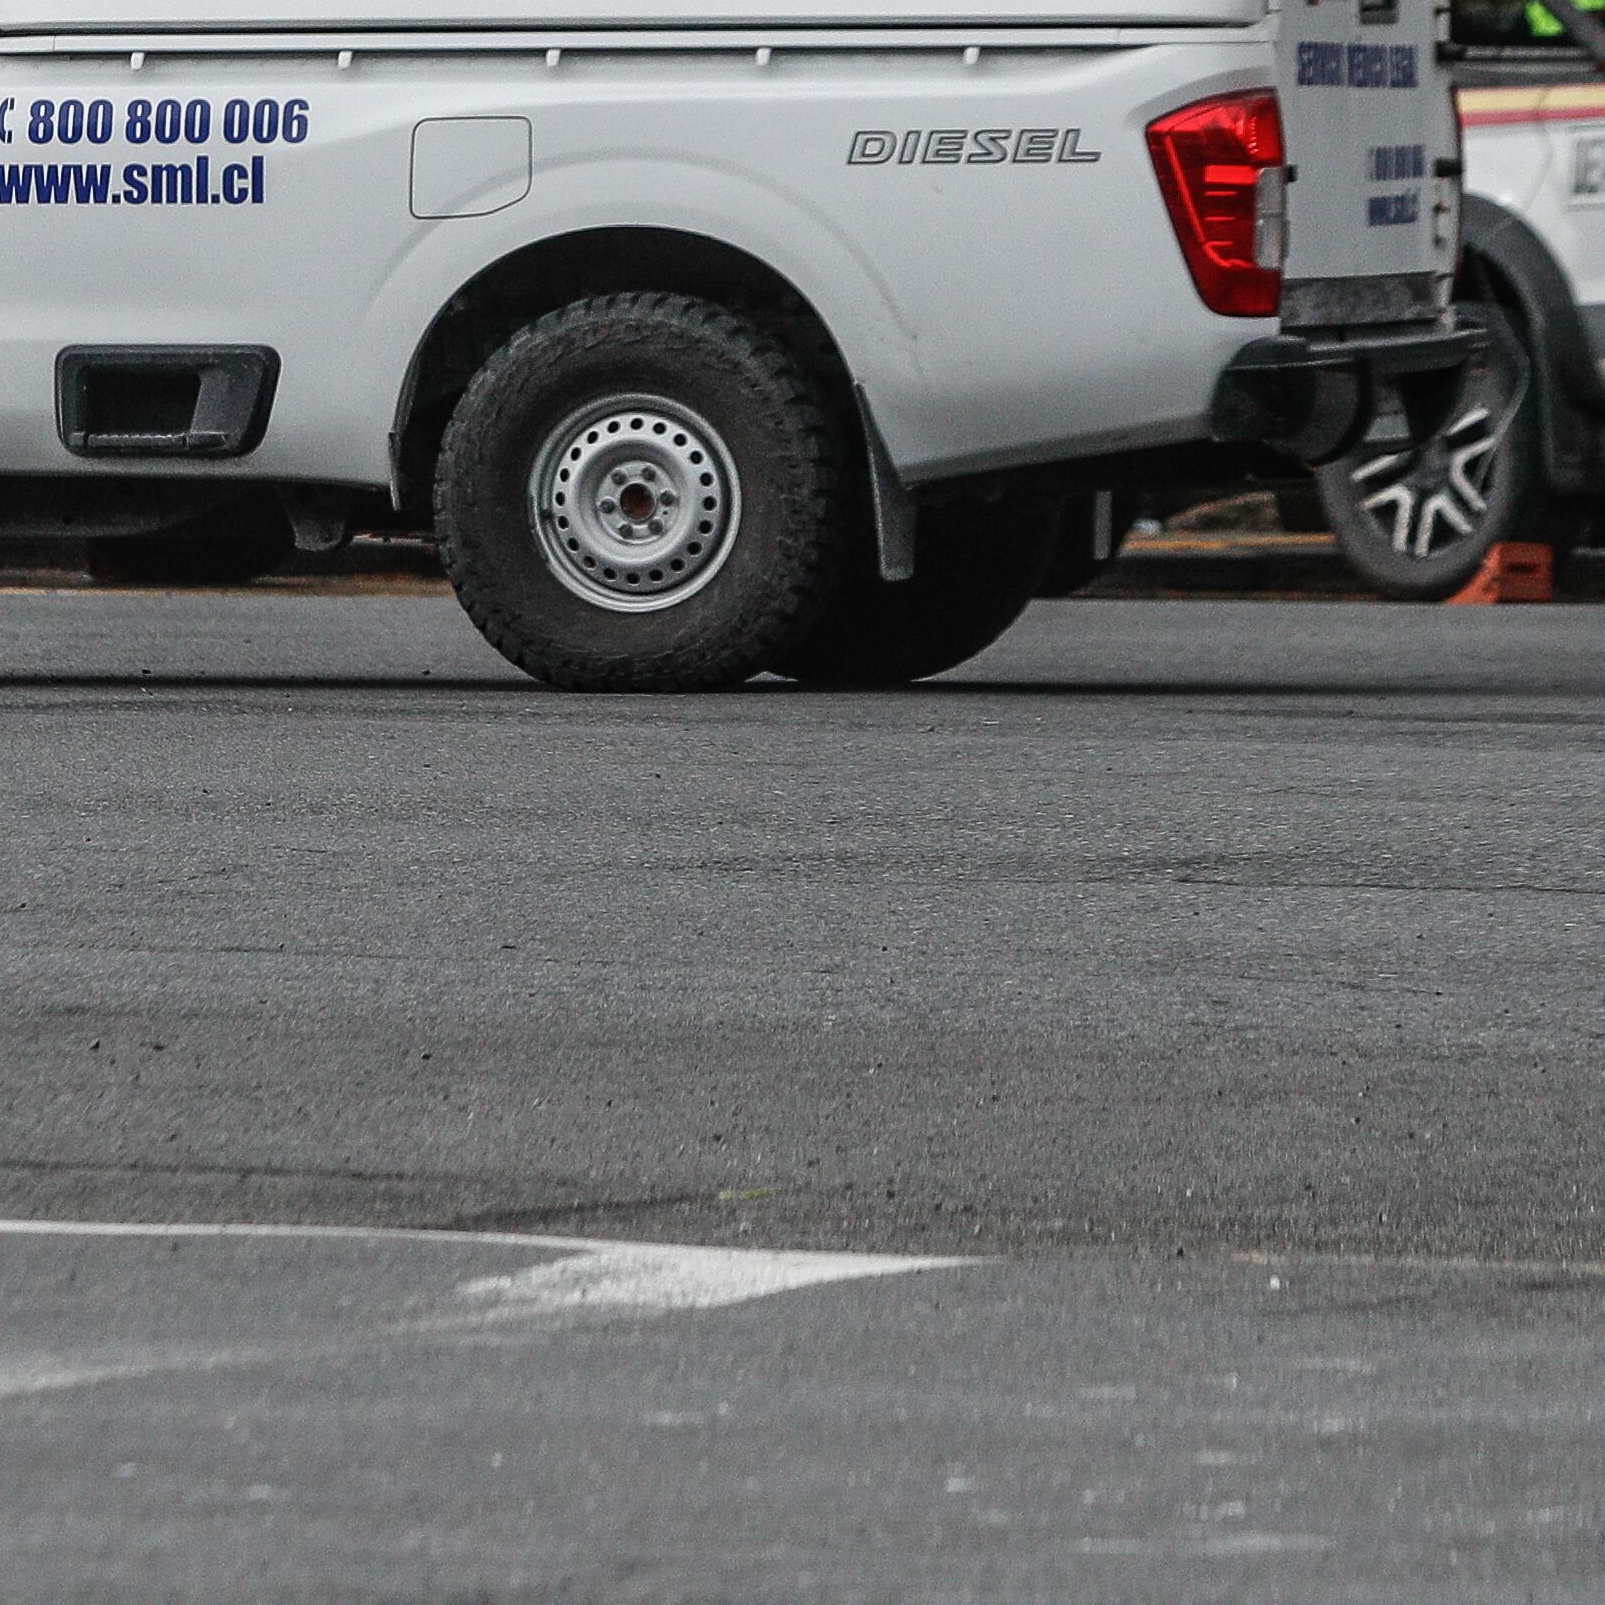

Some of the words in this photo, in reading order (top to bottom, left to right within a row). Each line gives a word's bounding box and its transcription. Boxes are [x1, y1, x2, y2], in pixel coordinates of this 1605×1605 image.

[28, 98, 114, 144] 800
[125, 98, 212, 144] 800
[223, 98, 310, 144] 006
[847, 129, 1101, 165] DIESEL
